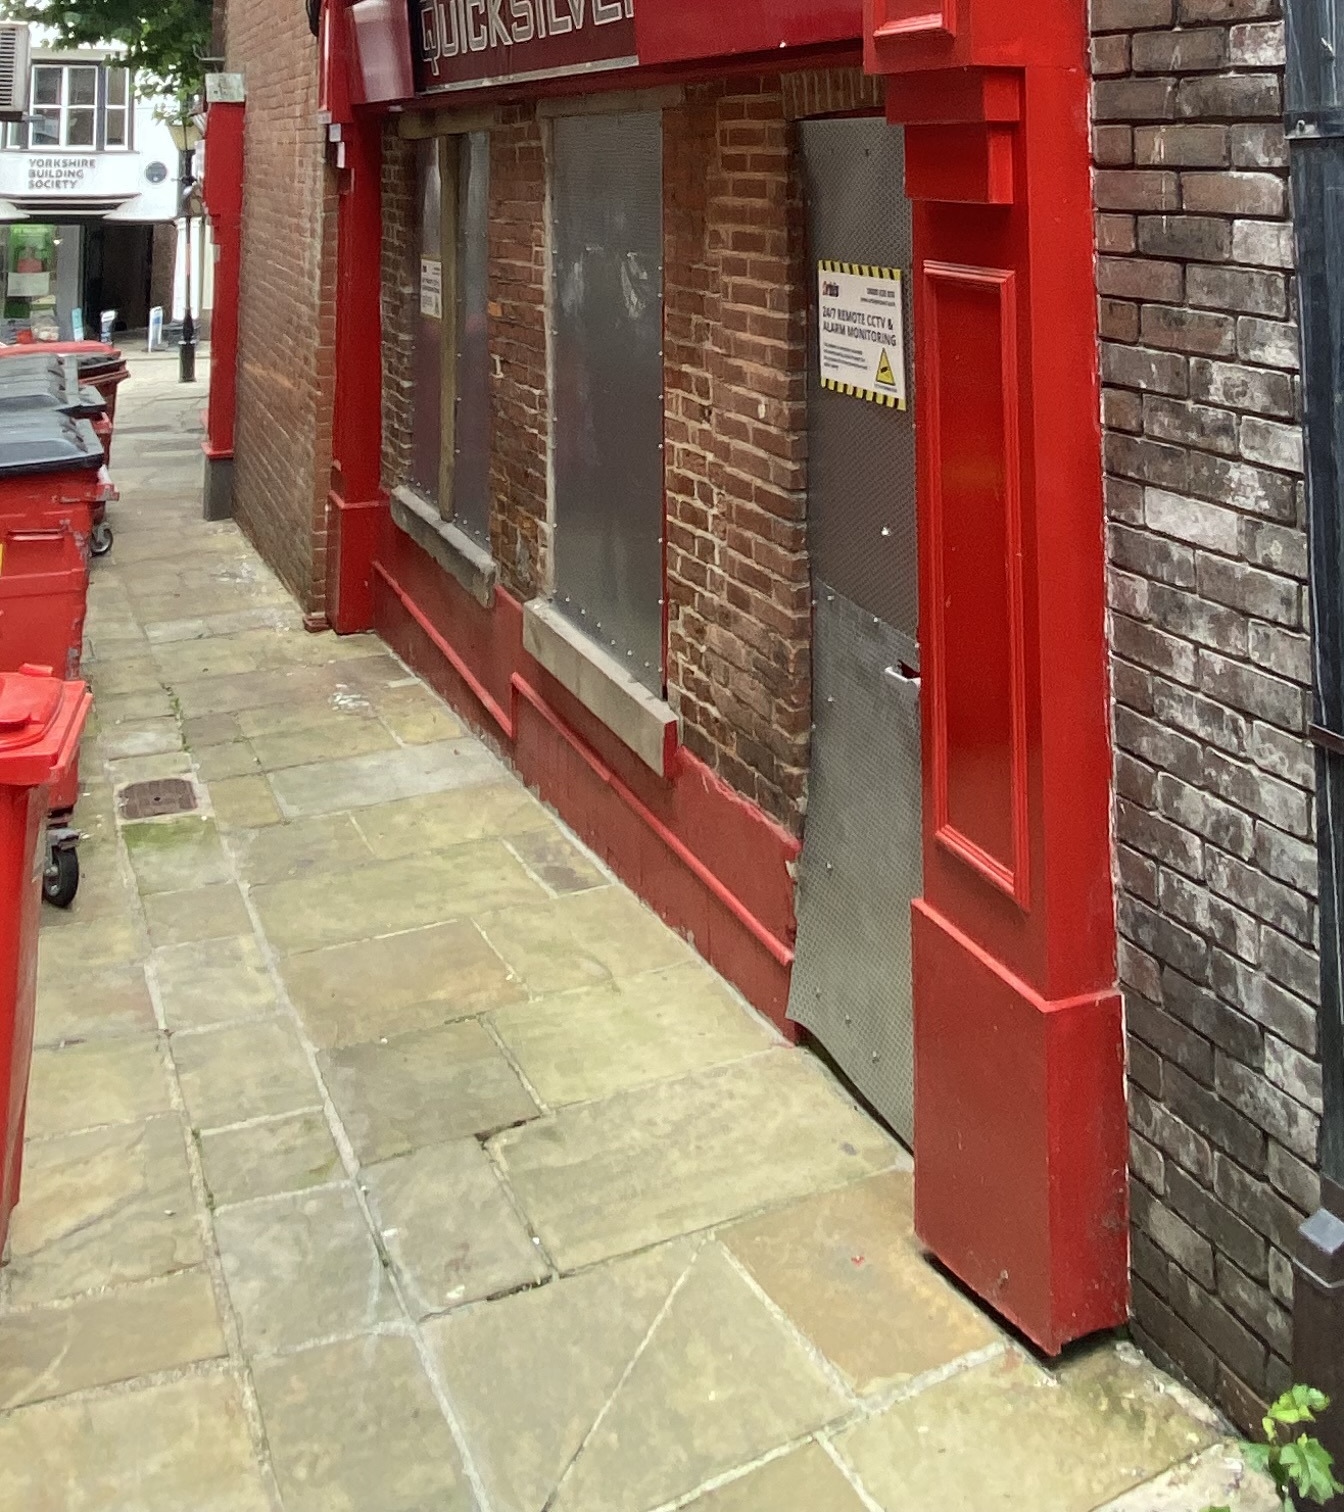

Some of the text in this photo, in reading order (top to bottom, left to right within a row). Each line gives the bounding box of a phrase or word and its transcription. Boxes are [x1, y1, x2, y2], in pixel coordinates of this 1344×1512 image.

[28, 158, 96, 168] YORKSHIRE
[28, 169, 84, 179] BUILDING
[28, 179, 78, 189] SOCIETY
[837, 308, 866, 326] REMOTE
[866, 314, 886, 329] CCTV
[823, 321, 897, 347] ALARM MONITORING
